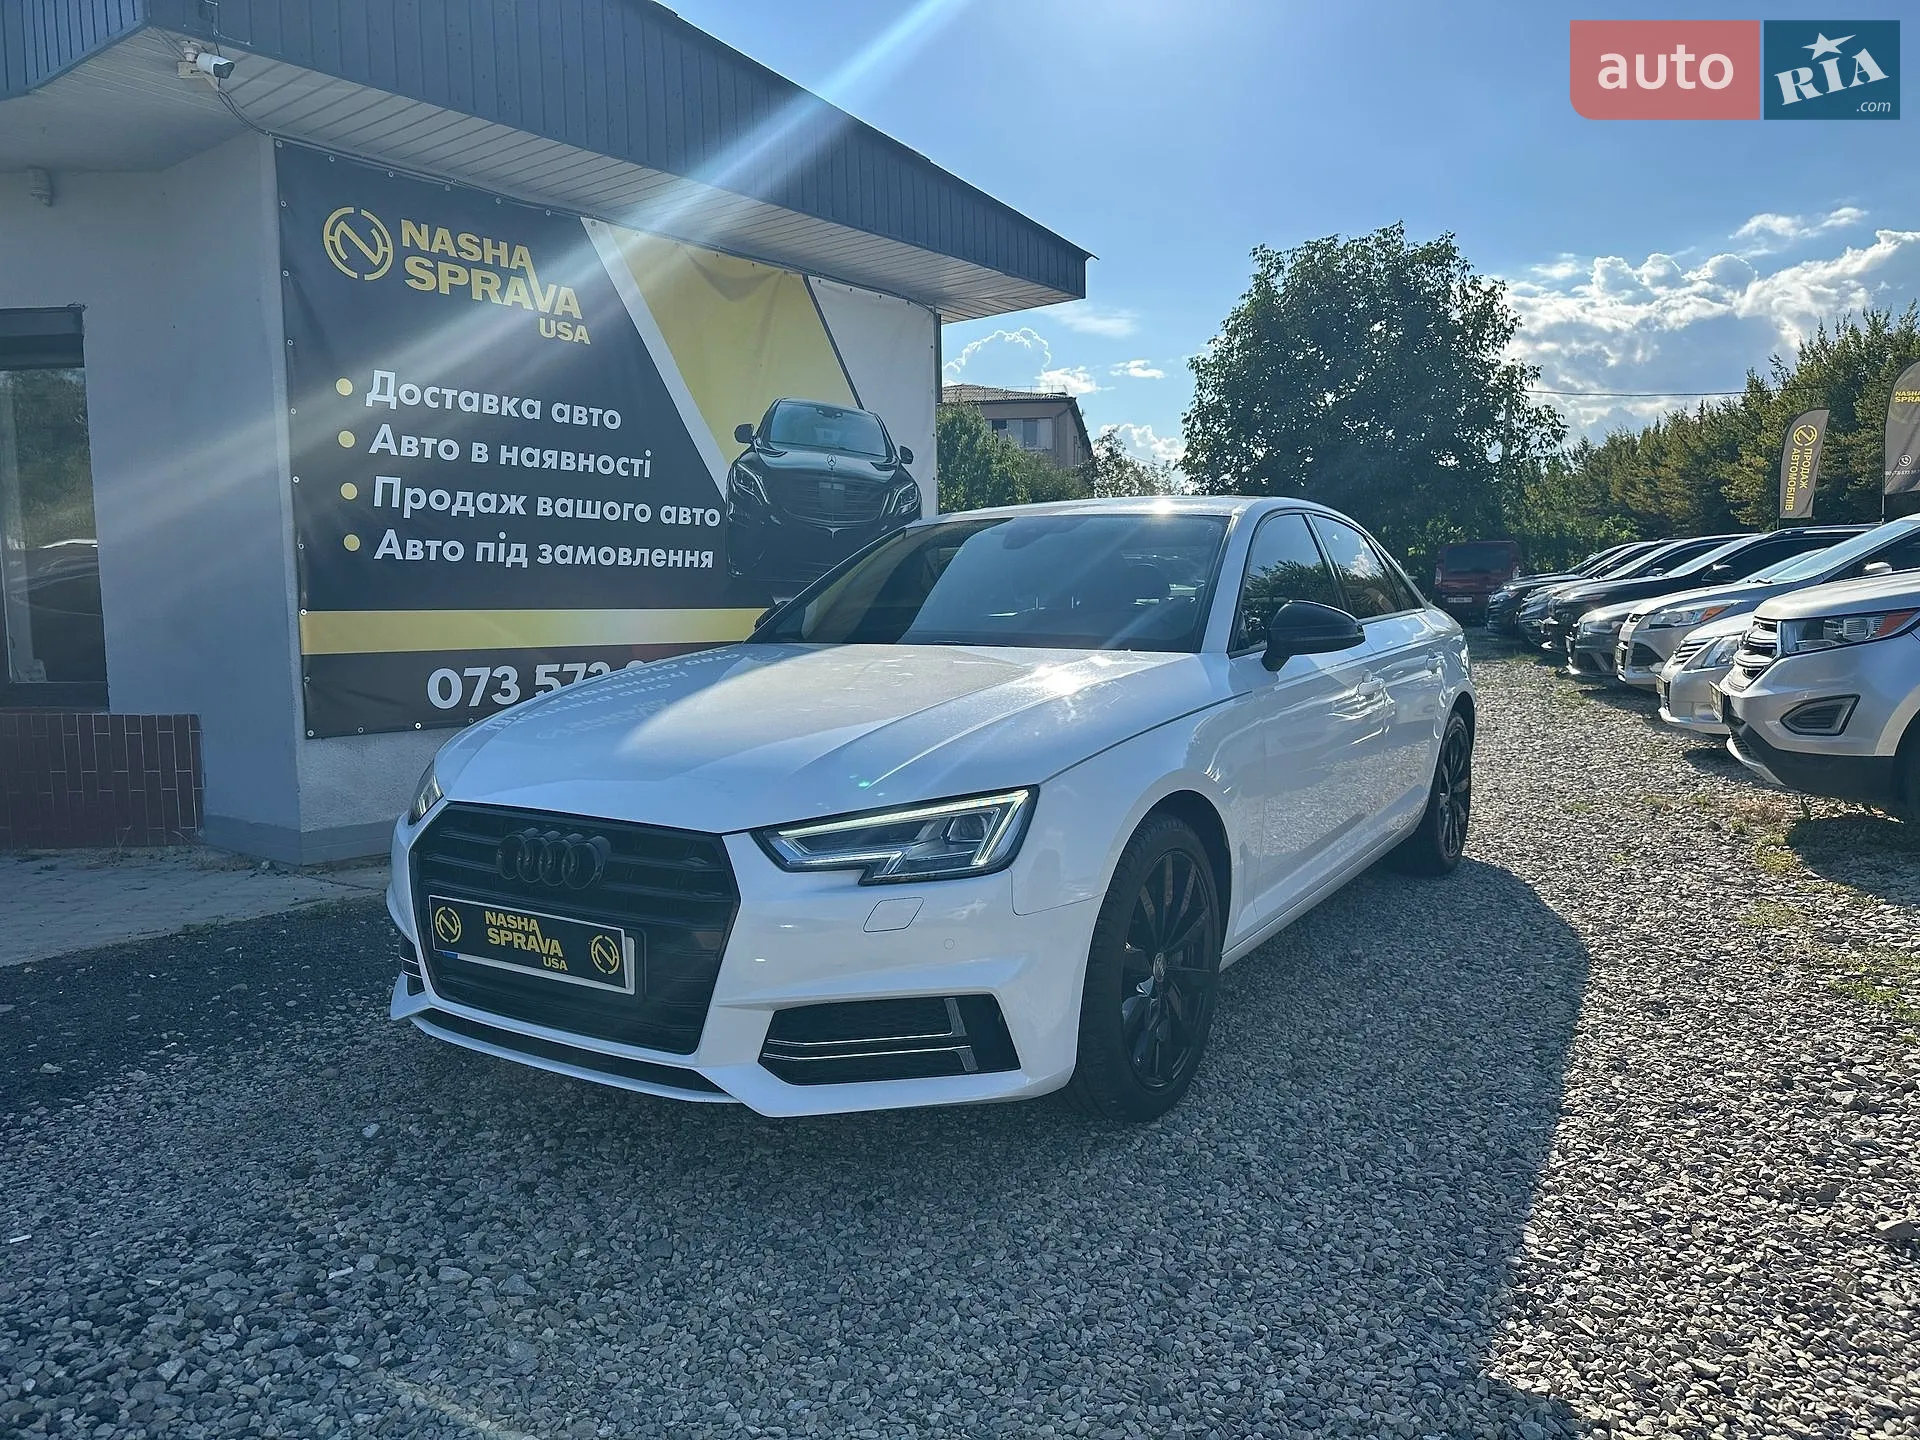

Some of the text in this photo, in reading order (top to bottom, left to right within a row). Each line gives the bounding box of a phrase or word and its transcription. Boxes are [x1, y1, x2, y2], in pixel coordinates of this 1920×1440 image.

[401, 219, 530, 270] NASHA
[404, 256, 582, 320] SPRAVA
[539, 317, 591, 345] USA
[365, 369, 622, 430] Доставка авто
[368, 423, 651, 478] Авто в наявності
[1799, 448, 1812, 489] ПРОДАЖ
[373, 475, 721, 528] Продаж вашого авто
[373, 528, 714, 569] Авто під замовлення
[427, 665, 520, 709] 073
[484, 911, 539, 932] NASHA
[487, 927, 564, 957] SPRAVA
[542, 957, 568, 971] USA
